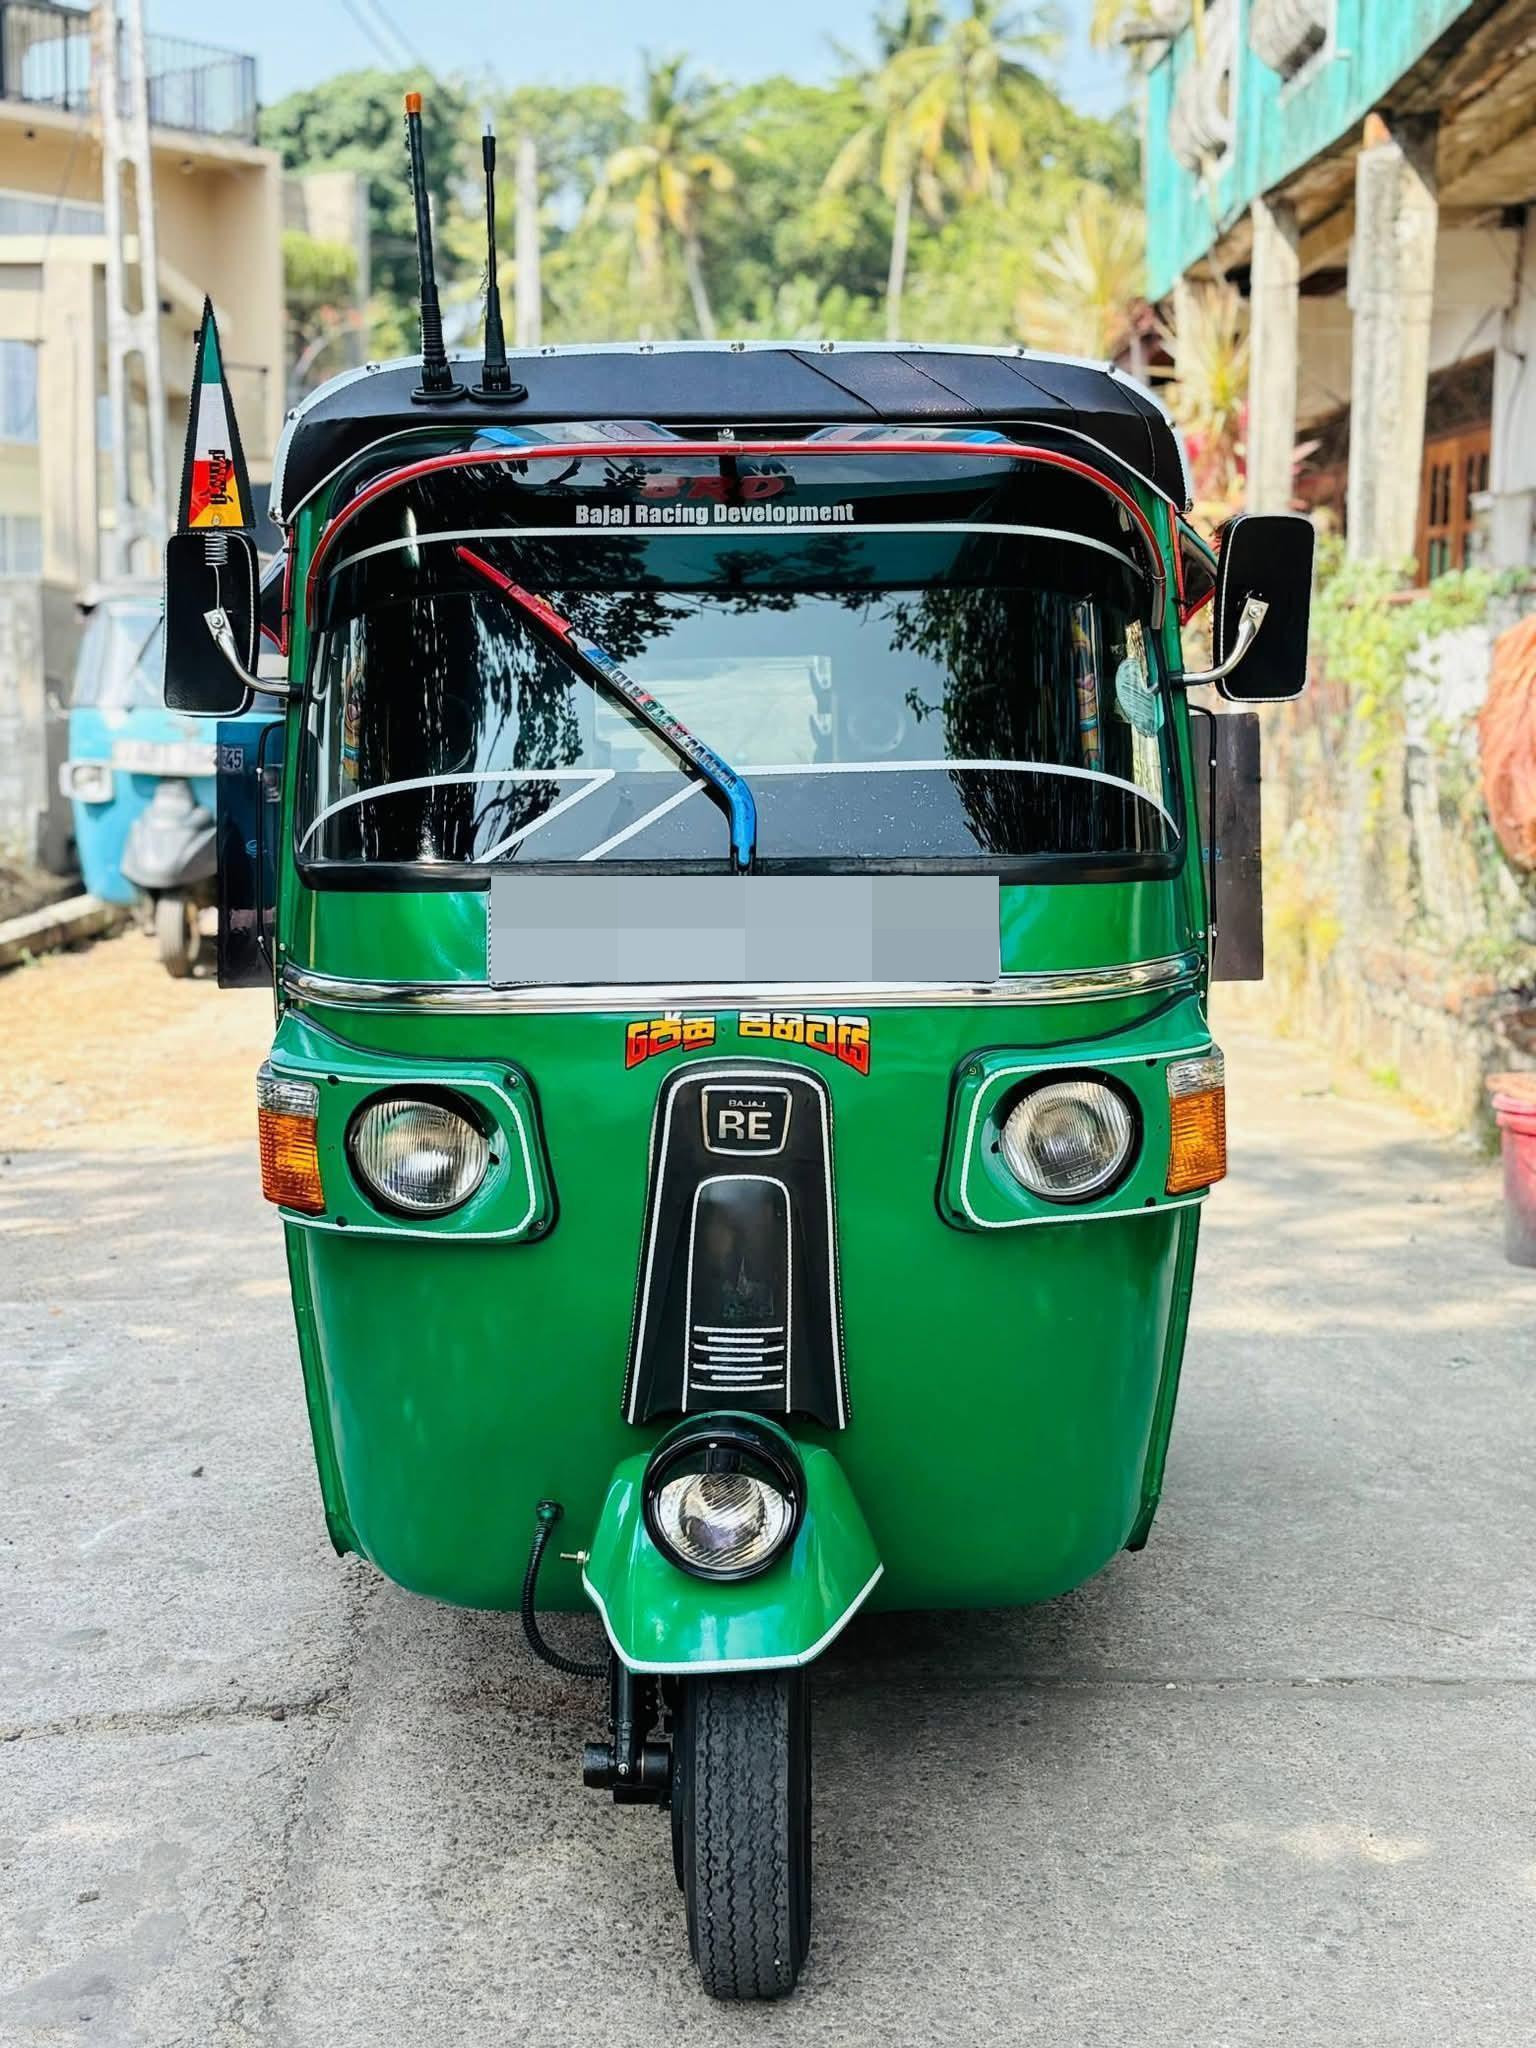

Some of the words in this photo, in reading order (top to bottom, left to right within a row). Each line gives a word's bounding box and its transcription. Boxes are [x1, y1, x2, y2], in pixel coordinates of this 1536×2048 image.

[575, 504, 630, 526] Bajaj
[635, 503, 709, 526] Racing
[713, 502, 855, 525] Development
[728, 1098, 767, 1109] BAJAJ
[717, 1110, 773, 1141] RE
